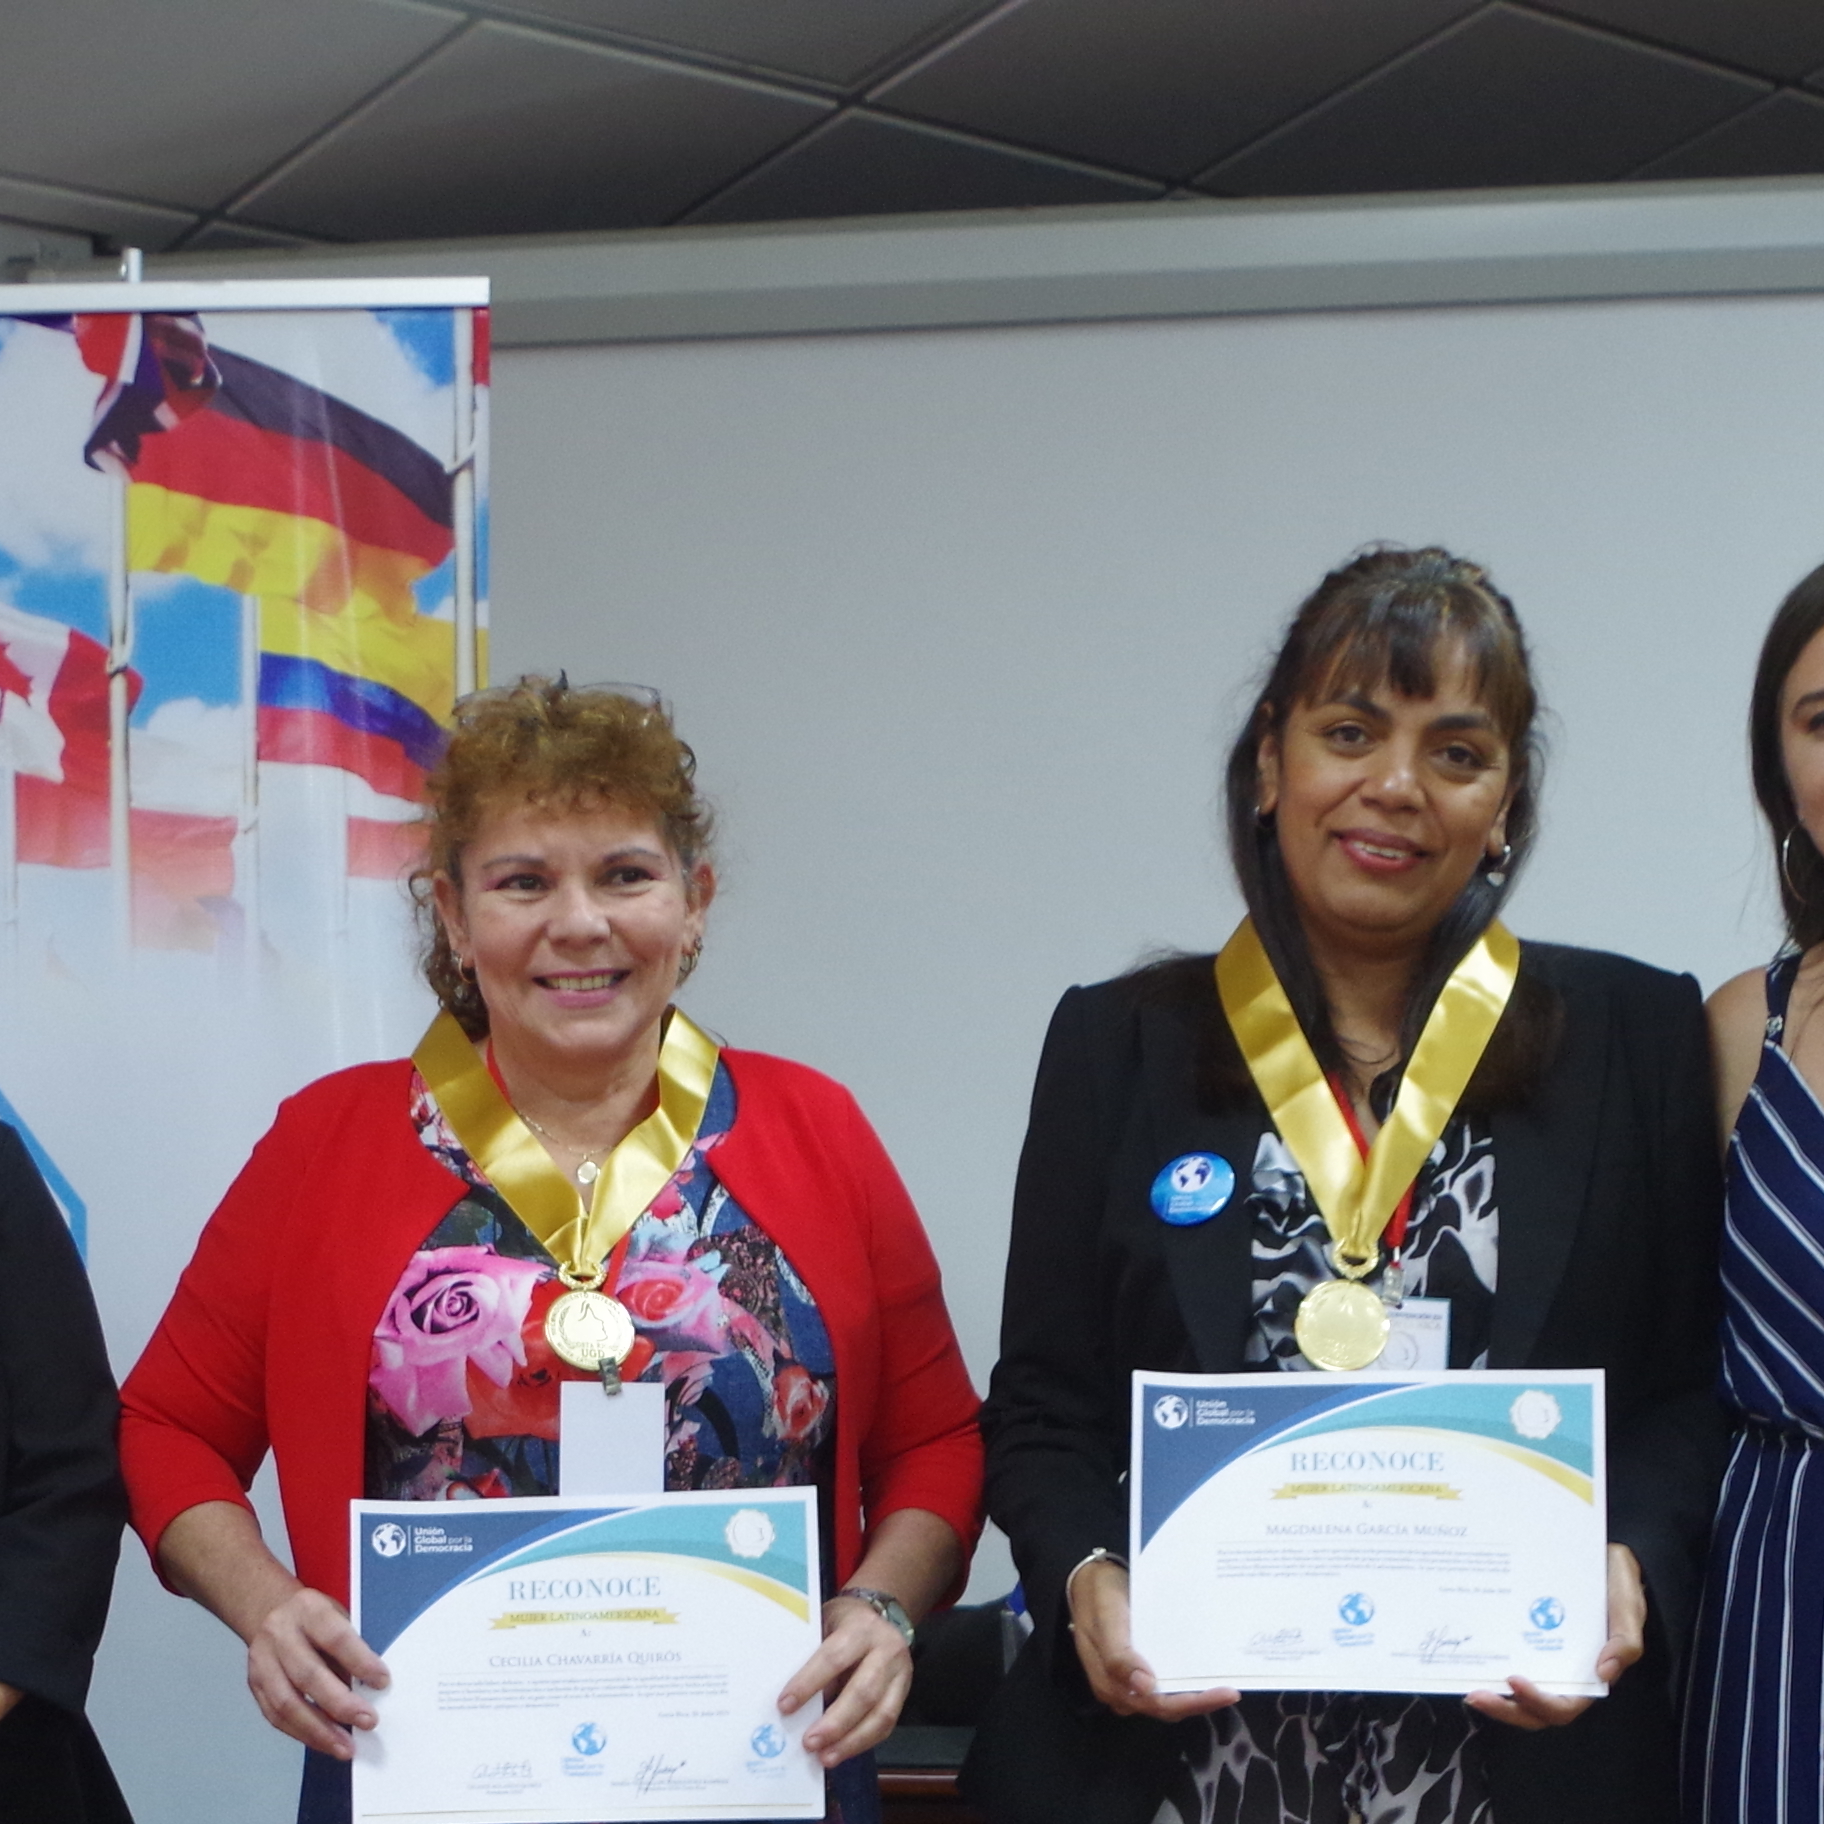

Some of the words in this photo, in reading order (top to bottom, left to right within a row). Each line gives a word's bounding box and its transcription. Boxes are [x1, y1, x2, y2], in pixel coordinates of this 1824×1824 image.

[581, 1349, 605, 1358] UGD
[1290, 1451, 1444, 1473] RECONOCE
[414, 1526, 445, 1535] Unión
[414, 1534, 447, 1544] Global
[415, 1543, 473, 1553] Democracia
[508, 1576, 661, 1601] RECONOCE
[510, 1612, 546, 1623] MUJER
[550, 1609, 659, 1622] LATINOAMERICANA
